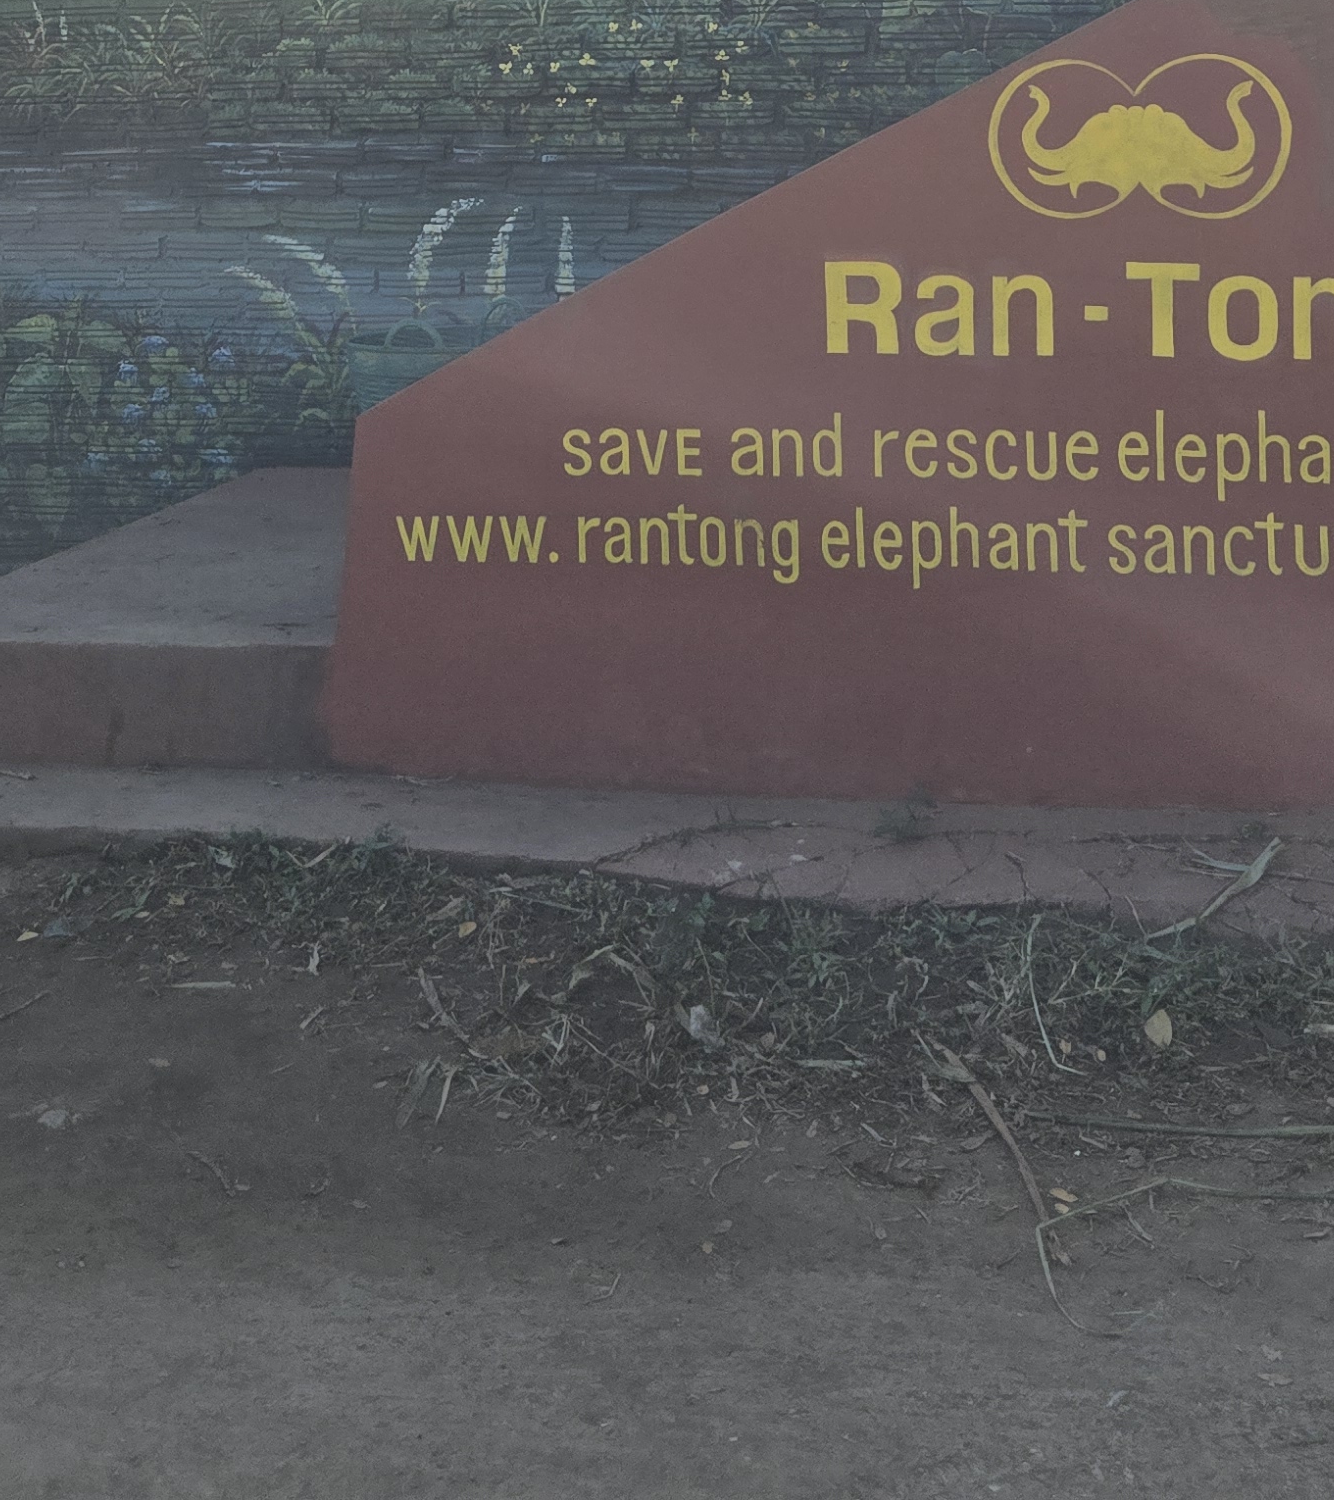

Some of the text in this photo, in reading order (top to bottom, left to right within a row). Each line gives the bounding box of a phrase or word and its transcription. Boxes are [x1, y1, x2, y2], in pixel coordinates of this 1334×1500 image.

[730, 411, 843, 478] and
[873, 428, 1100, 482] rescue
[821, 506, 1088, 590] elephant
